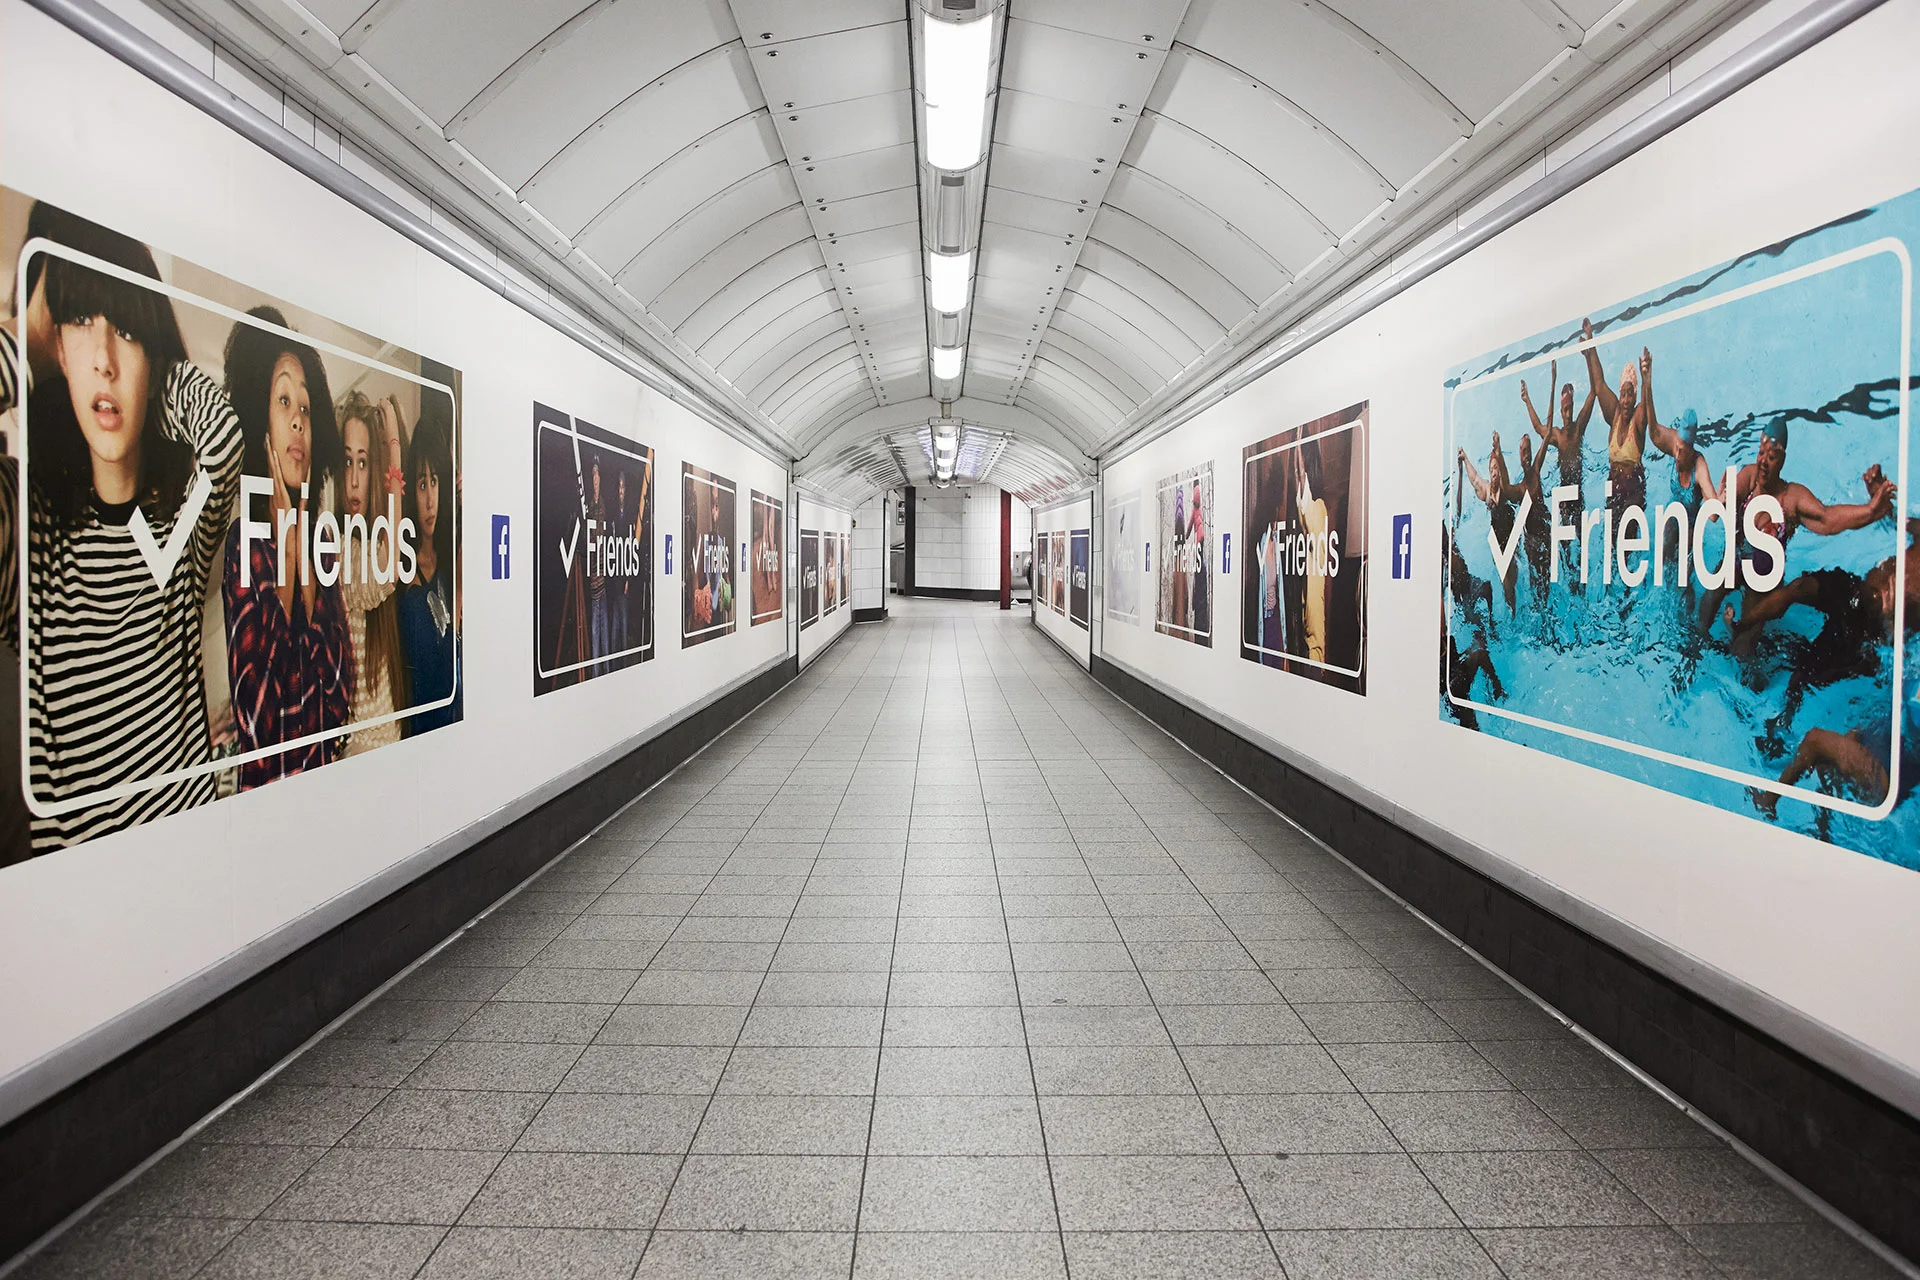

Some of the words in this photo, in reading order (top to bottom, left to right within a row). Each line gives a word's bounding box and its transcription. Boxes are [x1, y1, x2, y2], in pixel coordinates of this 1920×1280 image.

[240, 473, 417, 588] Friends
[586, 519, 640, 578] Friends
[703, 533, 730, 574] Friends
[762, 541, 778, 572] Friends
[1172, 534, 1202, 574] Friends
[1275, 515, 1339, 578] Friends
[1549, 465, 1786, 594] Friends
